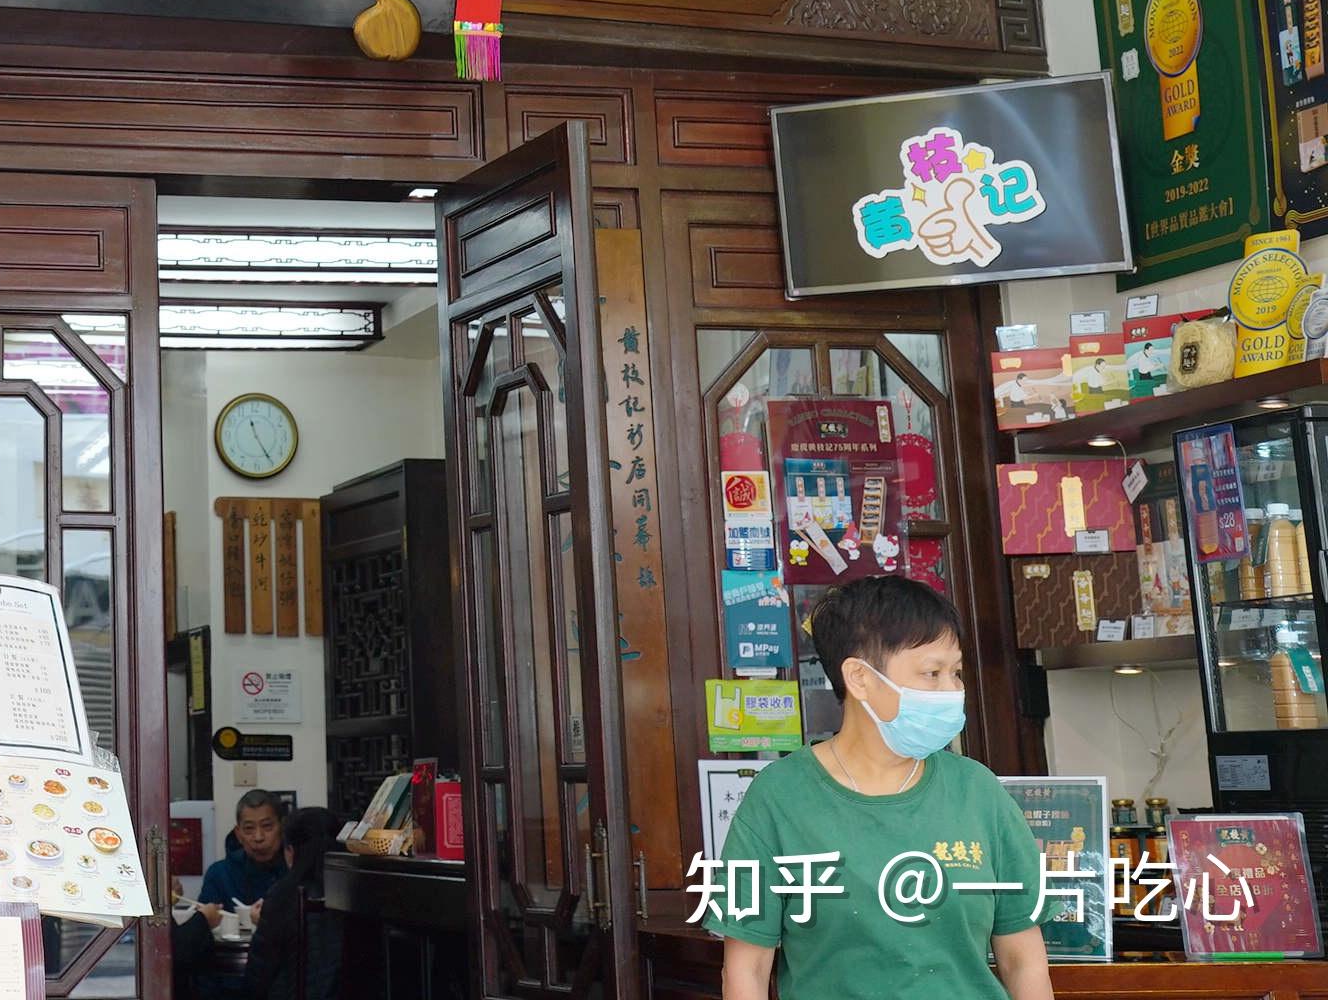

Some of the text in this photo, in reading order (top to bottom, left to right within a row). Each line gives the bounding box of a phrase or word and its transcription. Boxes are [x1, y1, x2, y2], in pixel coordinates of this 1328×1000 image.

[1165, 79, 1195, 104] GOLD
[1166, 98, 1197, 117] AWARD
[1165, 178, 1209, 203] 2019-2022
[1233, 260, 1260, 296] MONDE
[1256, 305, 1277, 315] 2019
[1241, 335, 1285, 352] GOLD
[1240, 350, 1284, 363] AWARD
[754, 644, 779, 654] MPay
[746, 696, 793, 709] 膠袋收費
